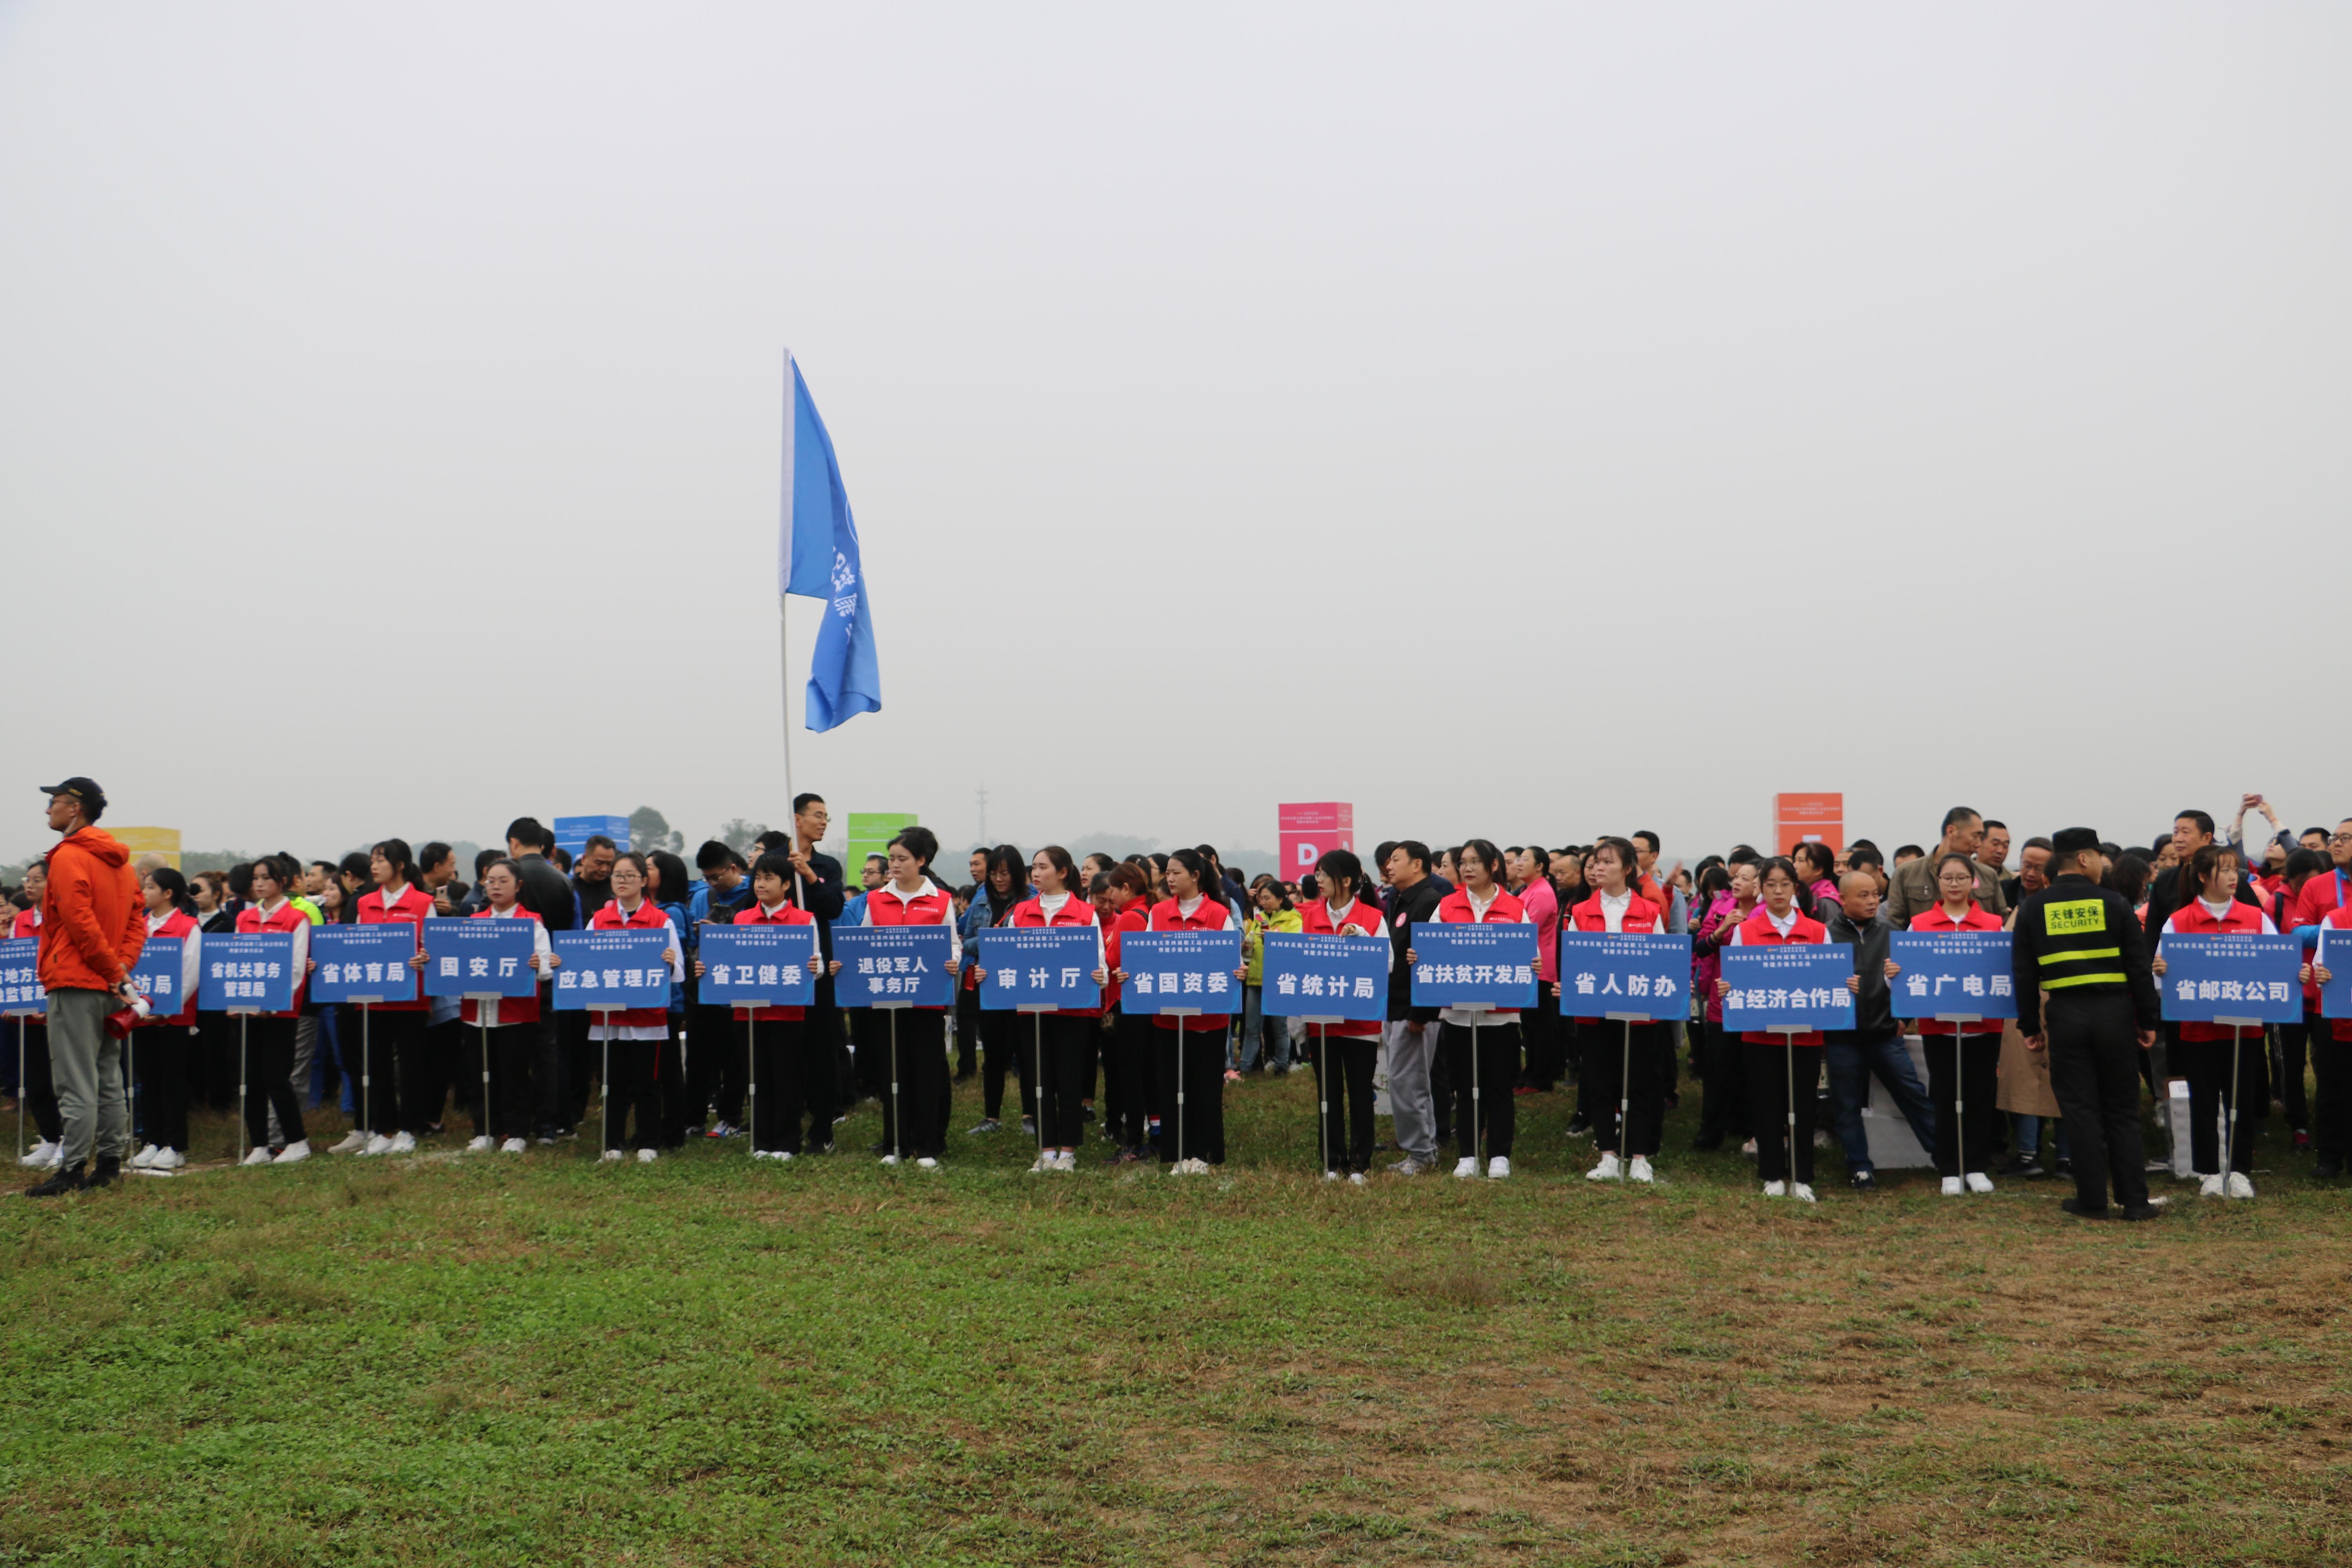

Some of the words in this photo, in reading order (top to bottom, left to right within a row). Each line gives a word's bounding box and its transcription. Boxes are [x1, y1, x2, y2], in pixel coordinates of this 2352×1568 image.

[1298, 843, 1319, 866] D
[2051, 918, 2098, 929] SECURITY
[0, 967, 41, 984] 地方
[211, 962, 280, 978] 省机关事务
[322, 962, 405, 983] 省体育局
[440, 956, 518, 977] 国安厅
[711, 964, 801, 985] 省卫健委
[858, 956, 928, 974] 退役军人
[1416, 964, 1533, 984] 省扶贫开发局
[134, 974, 172, 994] 访局
[558, 969, 664, 989] 应急管理厅
[868, 976, 920, 994] 事务厅
[998, 967, 1080, 989] 审计厅
[1134, 972, 1228, 994] 省国资委
[1276, 973, 1374, 998] 省统计局
[1575, 972, 1677, 997] 省人防办
[1906, 973, 2012, 996] 省广电局
[224, 981, 265, 997] 管理局
[1725, 987, 1851, 1009] 省经济合作局
[2176, 979, 2288, 1002] 省邮政公司
